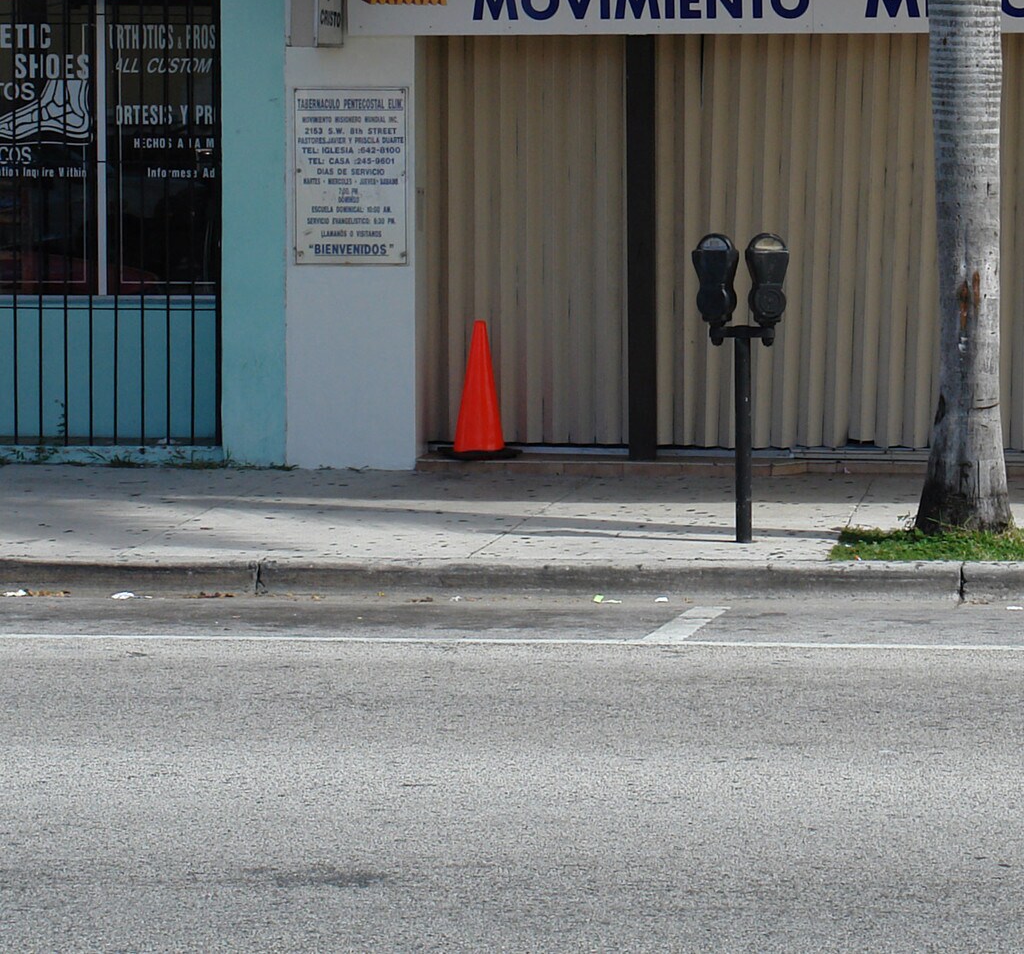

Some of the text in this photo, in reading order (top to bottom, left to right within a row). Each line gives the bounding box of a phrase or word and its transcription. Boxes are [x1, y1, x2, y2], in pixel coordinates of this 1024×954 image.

[320, 10, 340, 28] CRISTO
[15, 54, 89, 79] SHOES
[298, 99, 340, 109] TABERNACULO
[344, 99, 384, 109] PENTECOSTAL
[116, 105, 172, 125] ORTESIS
[180, 105, 188, 125] Y
